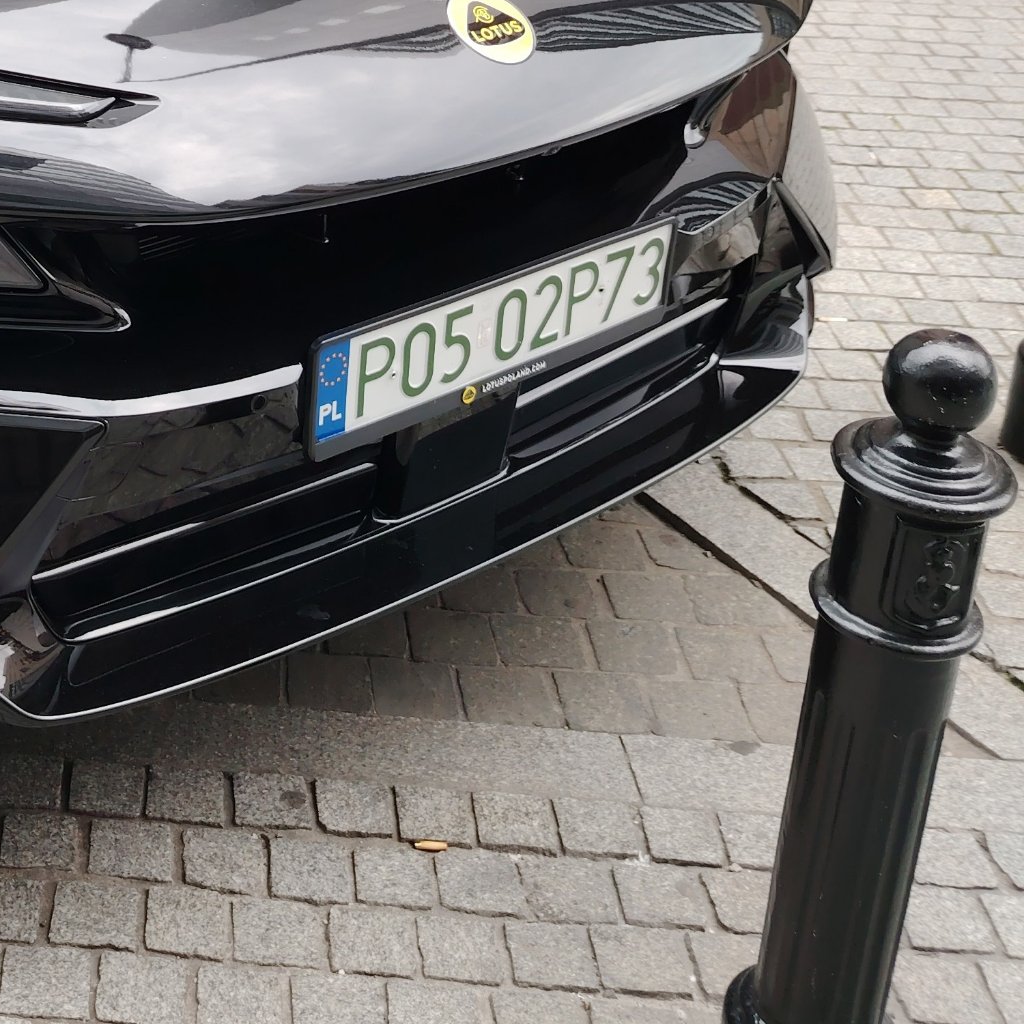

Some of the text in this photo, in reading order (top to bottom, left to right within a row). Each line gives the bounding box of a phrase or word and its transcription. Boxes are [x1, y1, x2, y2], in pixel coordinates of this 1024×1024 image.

[470, 20, 523, 43] LOTUS
[480, 359, 548, 394] LOTUSPOLAND.COM
[317, 399, 343, 427] PL
